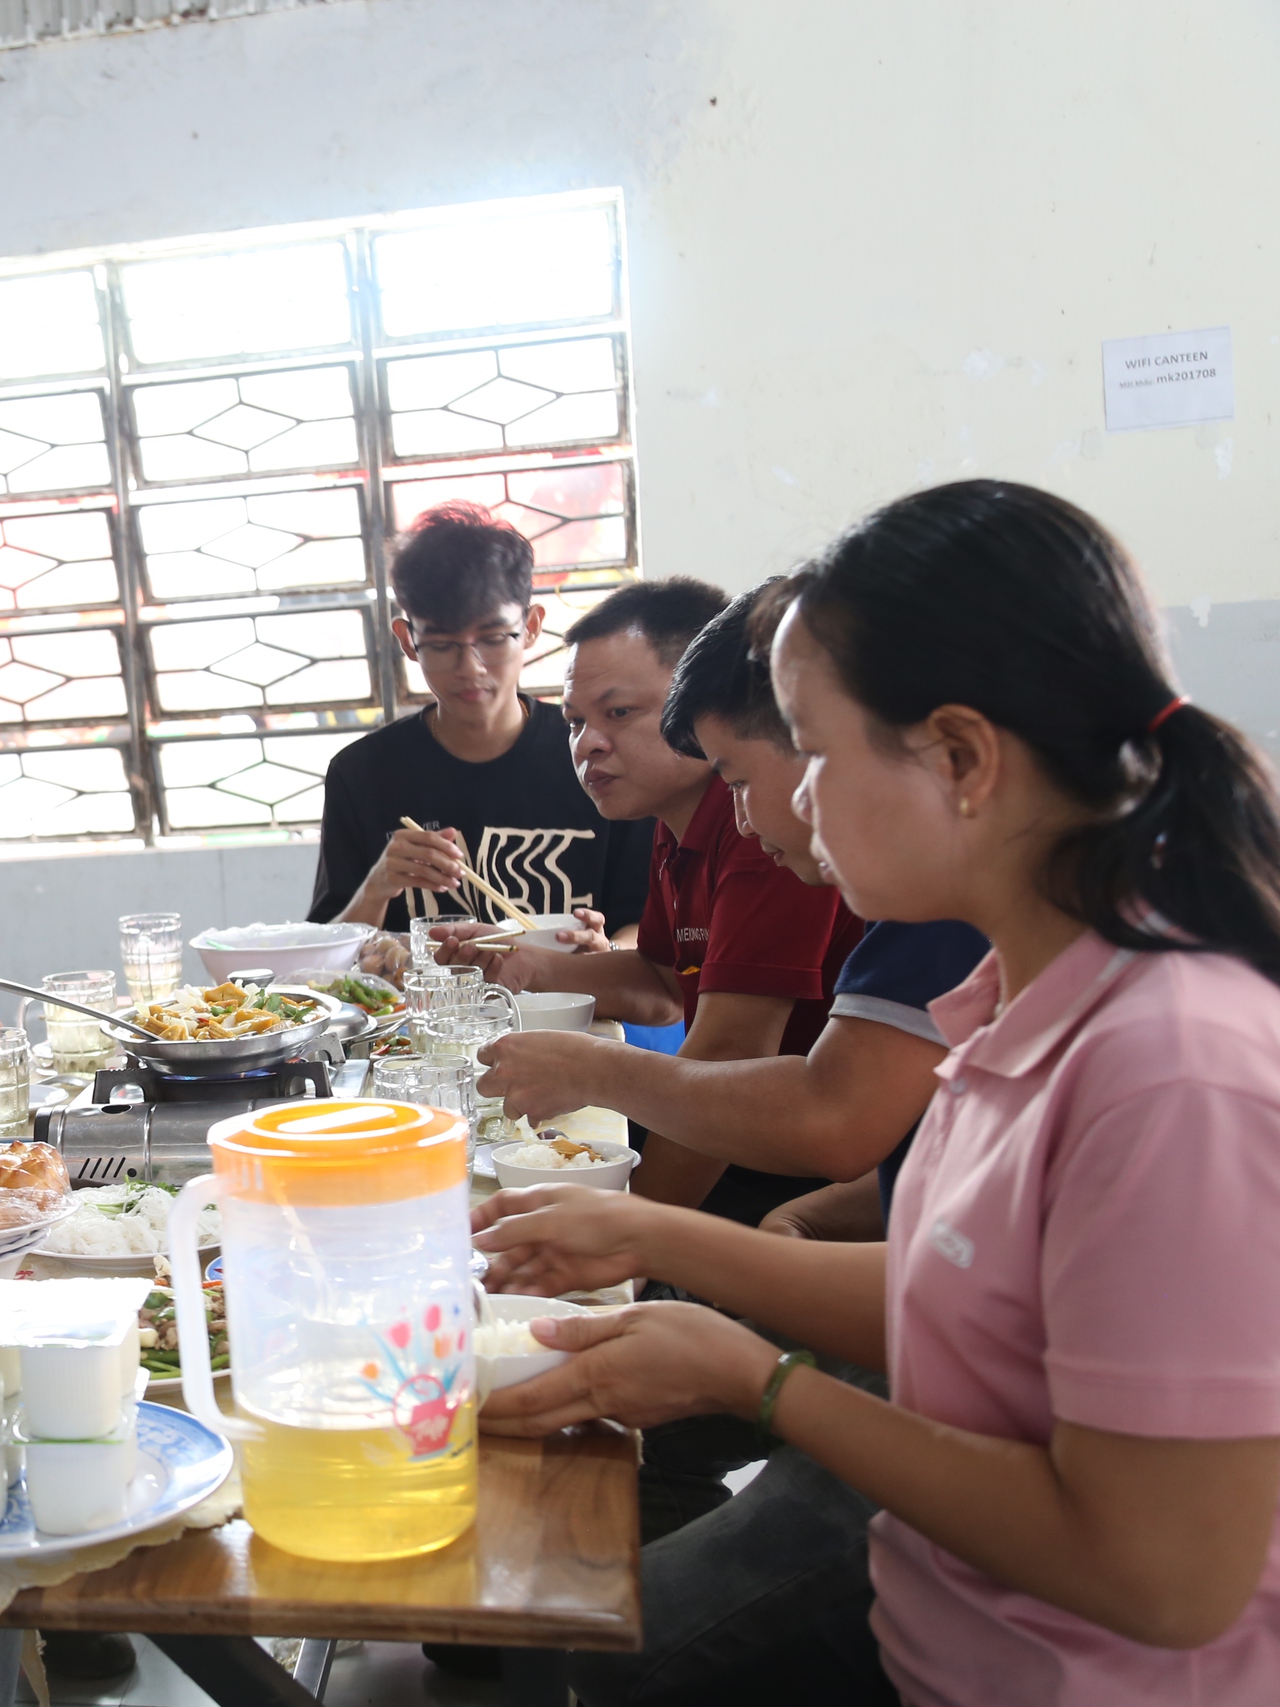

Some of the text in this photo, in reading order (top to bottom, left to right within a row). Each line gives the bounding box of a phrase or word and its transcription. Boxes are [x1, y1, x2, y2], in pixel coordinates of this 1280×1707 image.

[1124, 351, 1208, 370] WIFI CANTEEN
[1156, 368, 1216, 384] mk201708
